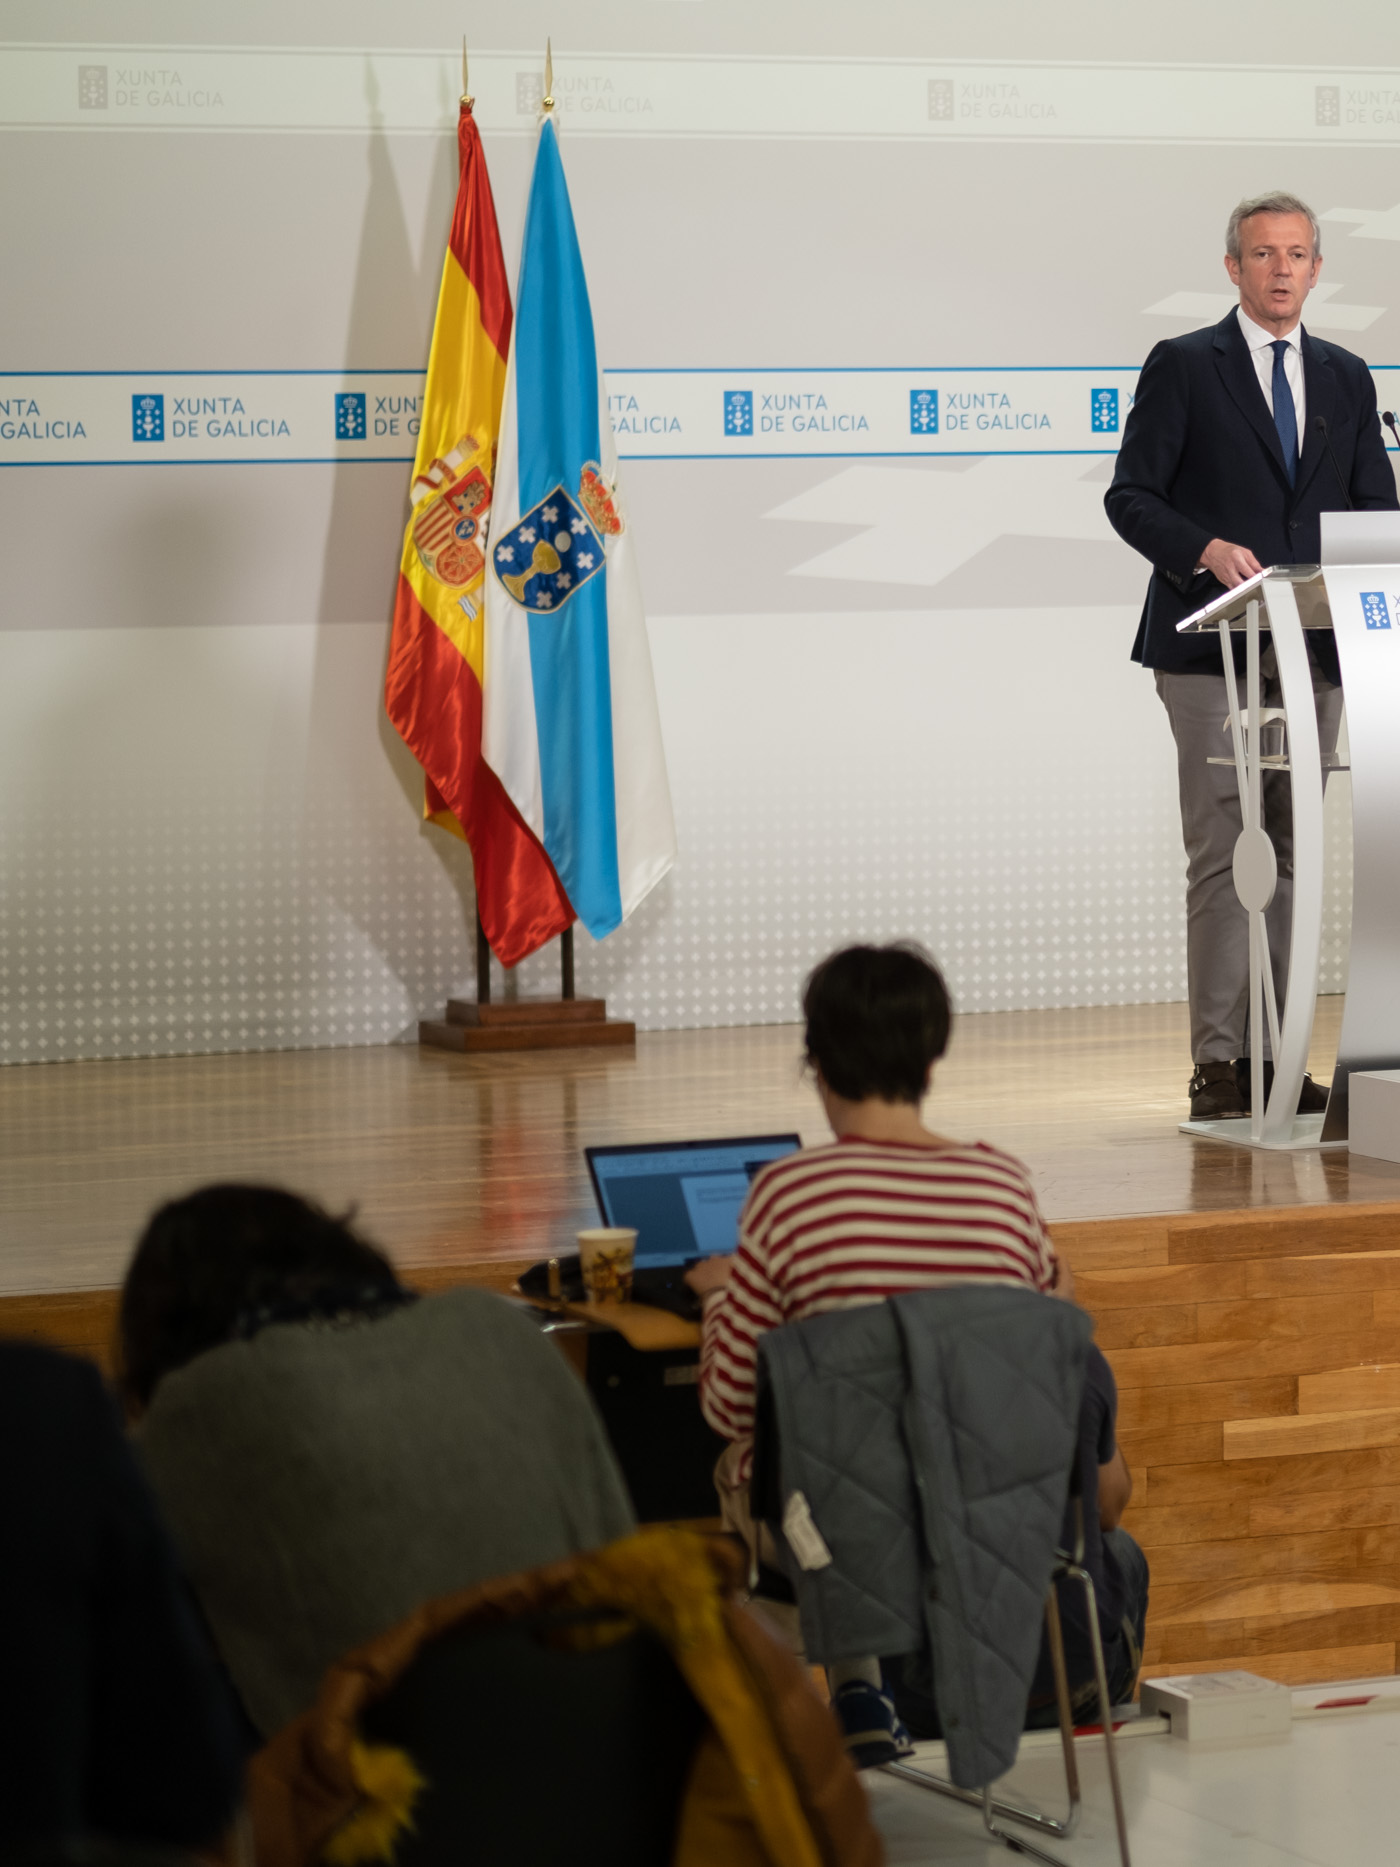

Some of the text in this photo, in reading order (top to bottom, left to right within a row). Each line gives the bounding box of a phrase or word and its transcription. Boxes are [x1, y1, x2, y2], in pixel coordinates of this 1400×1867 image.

[115, 69, 183, 86] XUNTA
[552, 76, 616, 93] XUNTA
[115, 89, 224, 107] DE GALICIA
[960, 83, 1021, 99] XUNTA
[580, 96, 654, 113] GALICIA
[960, 102, 1058, 119] DE GALICIA
[1346, 108, 1367, 124] DE
[173, 397, 245, 415] XUNTA
[375, 396, 424, 414] XUN
[761, 394, 828, 411] XUNTA
[946, 392, 1011, 410] XUNTA
[0, 421, 87, 439] GALICIA
[172, 419, 290, 438] DE GALICIA
[374, 418, 400, 436] DE
[760, 415, 869, 433] DE GALICIA
[945, 413, 1052, 431] DE GALICIA
